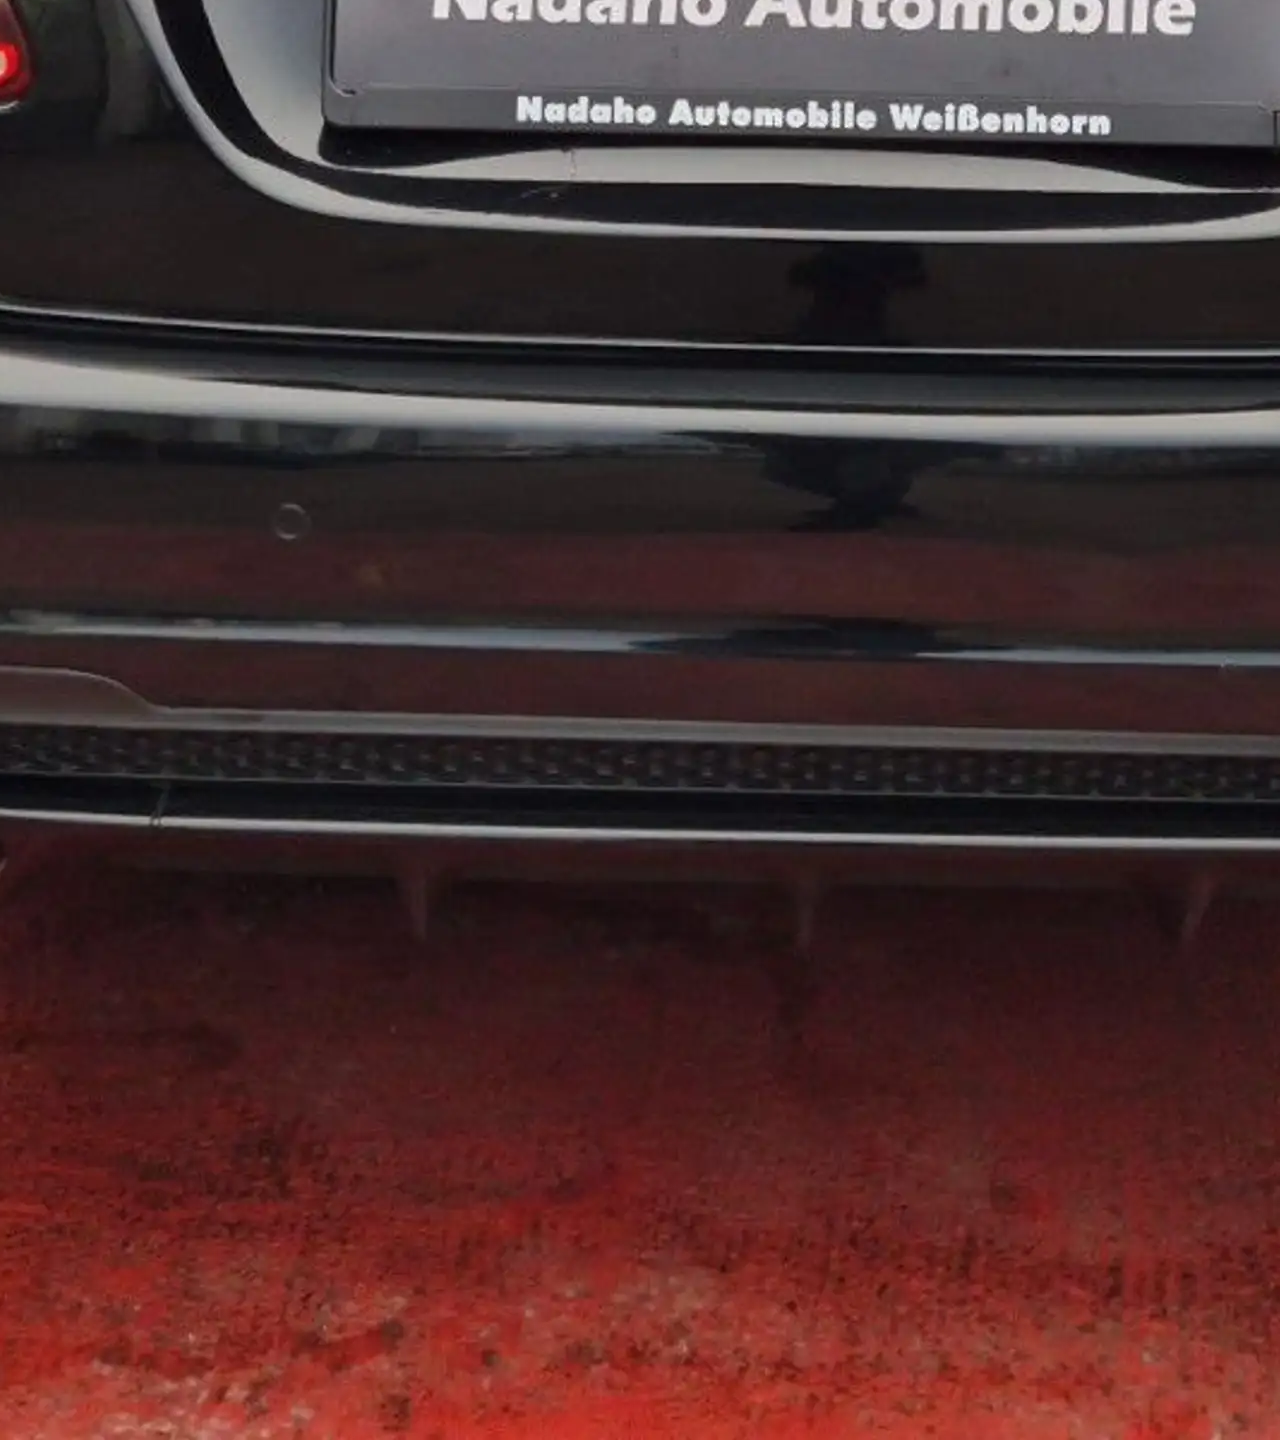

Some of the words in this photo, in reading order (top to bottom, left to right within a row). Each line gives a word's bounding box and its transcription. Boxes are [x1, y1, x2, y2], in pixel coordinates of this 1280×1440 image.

[515, 95, 657, 126] Nadaho
[667, 98, 878, 131] Automobile
[888, 102, 1112, 136] Weißenhorn
